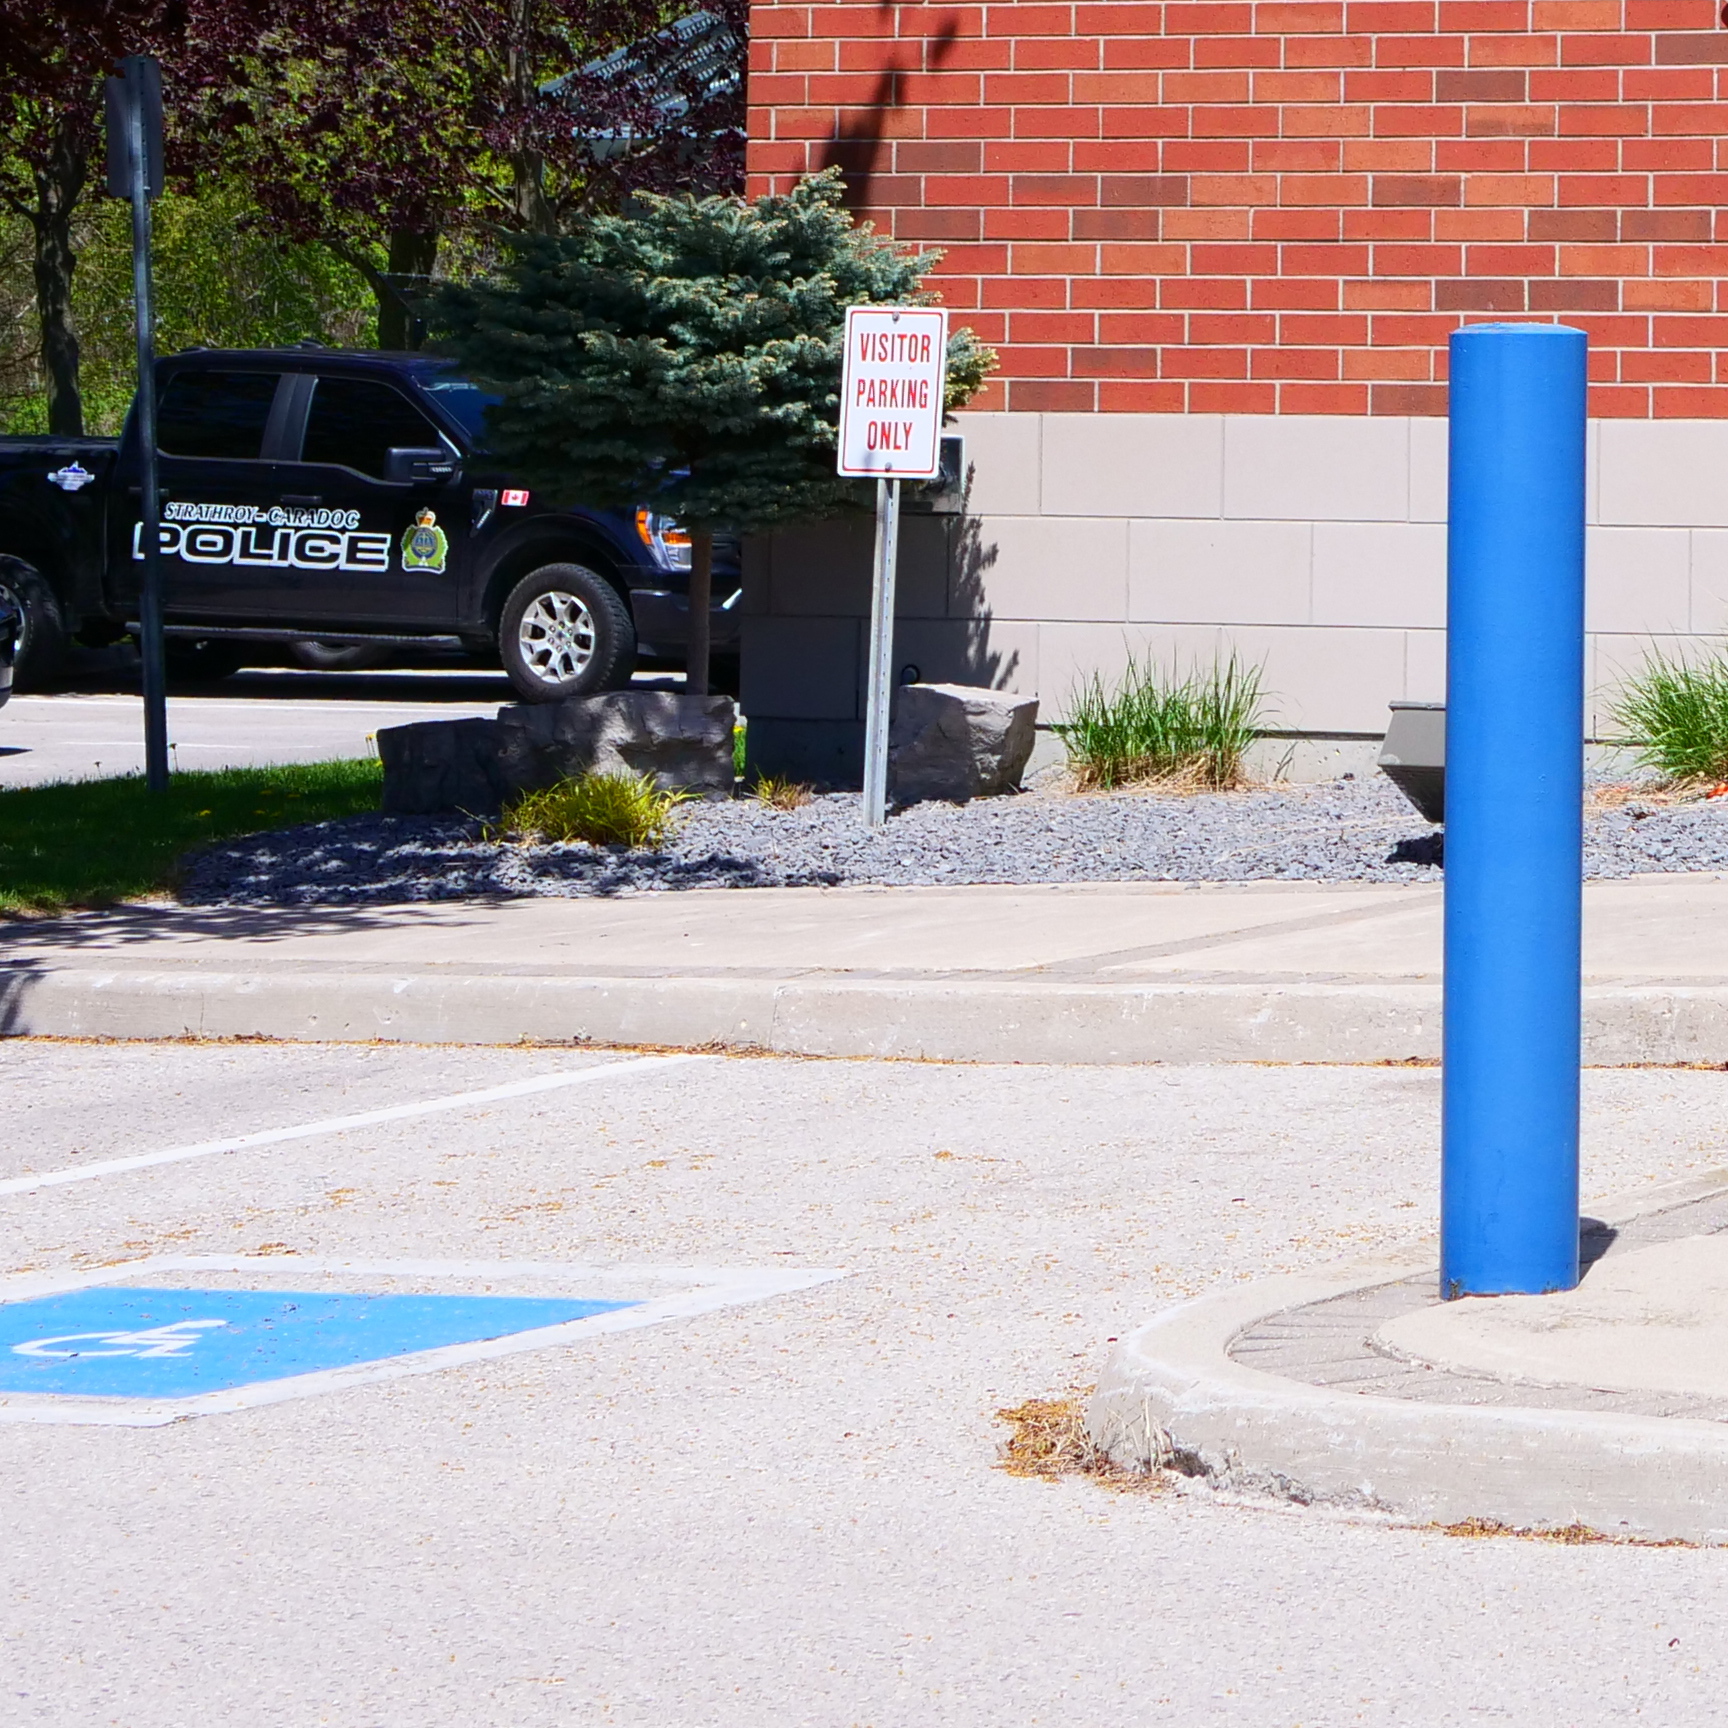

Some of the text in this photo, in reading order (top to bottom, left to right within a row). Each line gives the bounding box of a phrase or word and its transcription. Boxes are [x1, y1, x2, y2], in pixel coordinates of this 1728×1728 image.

[859, 332, 932, 364] VISITOR
[856, 378, 930, 410] PARKING
[866, 420, 914, 452] ONLY
[164, 501, 361, 529] STRATHROY-CARADOC
[132, 521, 392, 573] POLICE
